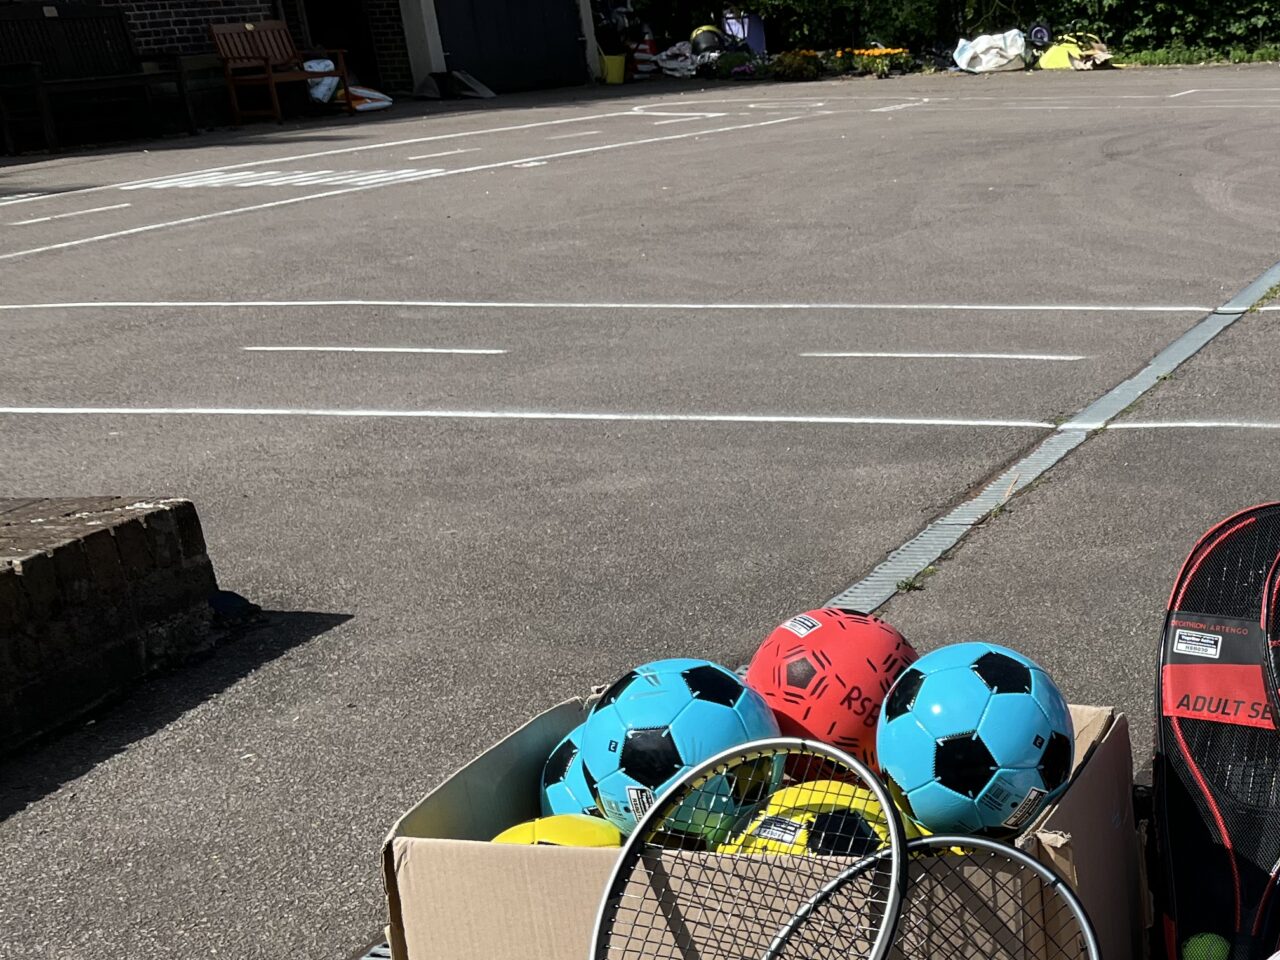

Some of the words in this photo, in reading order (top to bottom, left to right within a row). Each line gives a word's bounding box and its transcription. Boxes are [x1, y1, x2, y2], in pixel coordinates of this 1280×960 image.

[1210, 625, 1249, 635] ARTENGO
[1176, 694, 1245, 717] ADULT
[1247, 702, 1274, 720] SE
